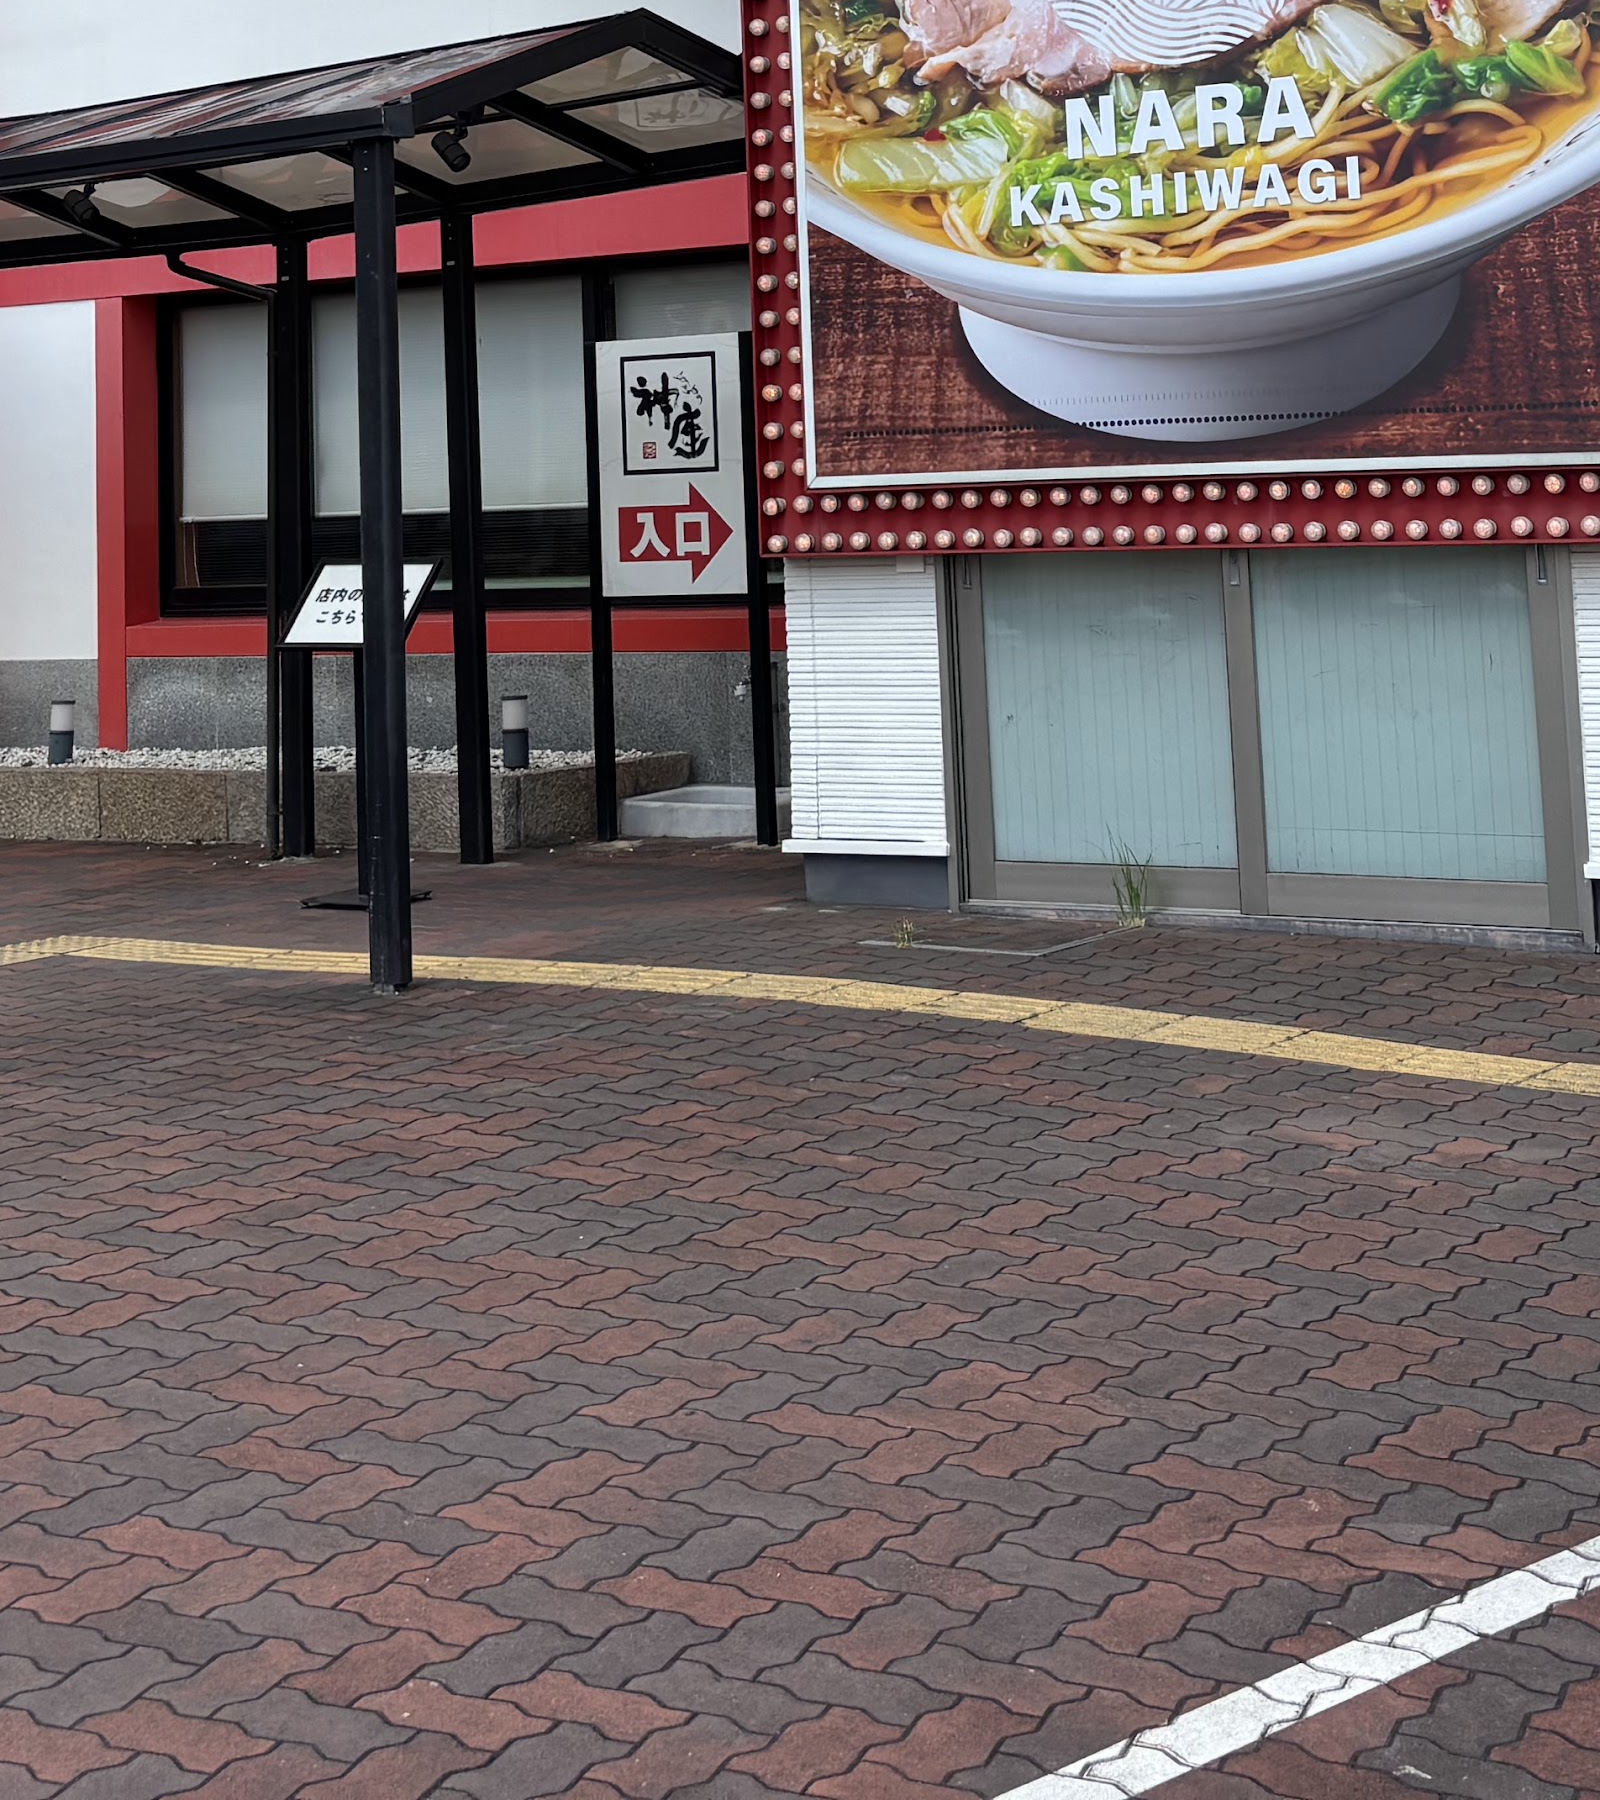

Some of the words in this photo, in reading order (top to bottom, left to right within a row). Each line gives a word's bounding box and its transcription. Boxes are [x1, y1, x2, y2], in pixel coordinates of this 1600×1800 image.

[1064, 75, 1316, 160] NARA
[1009, 155, 1362, 228] KASHIWAGI
[630, 511, 710, 559] 入口
[315, 610, 364, 625] こちら
